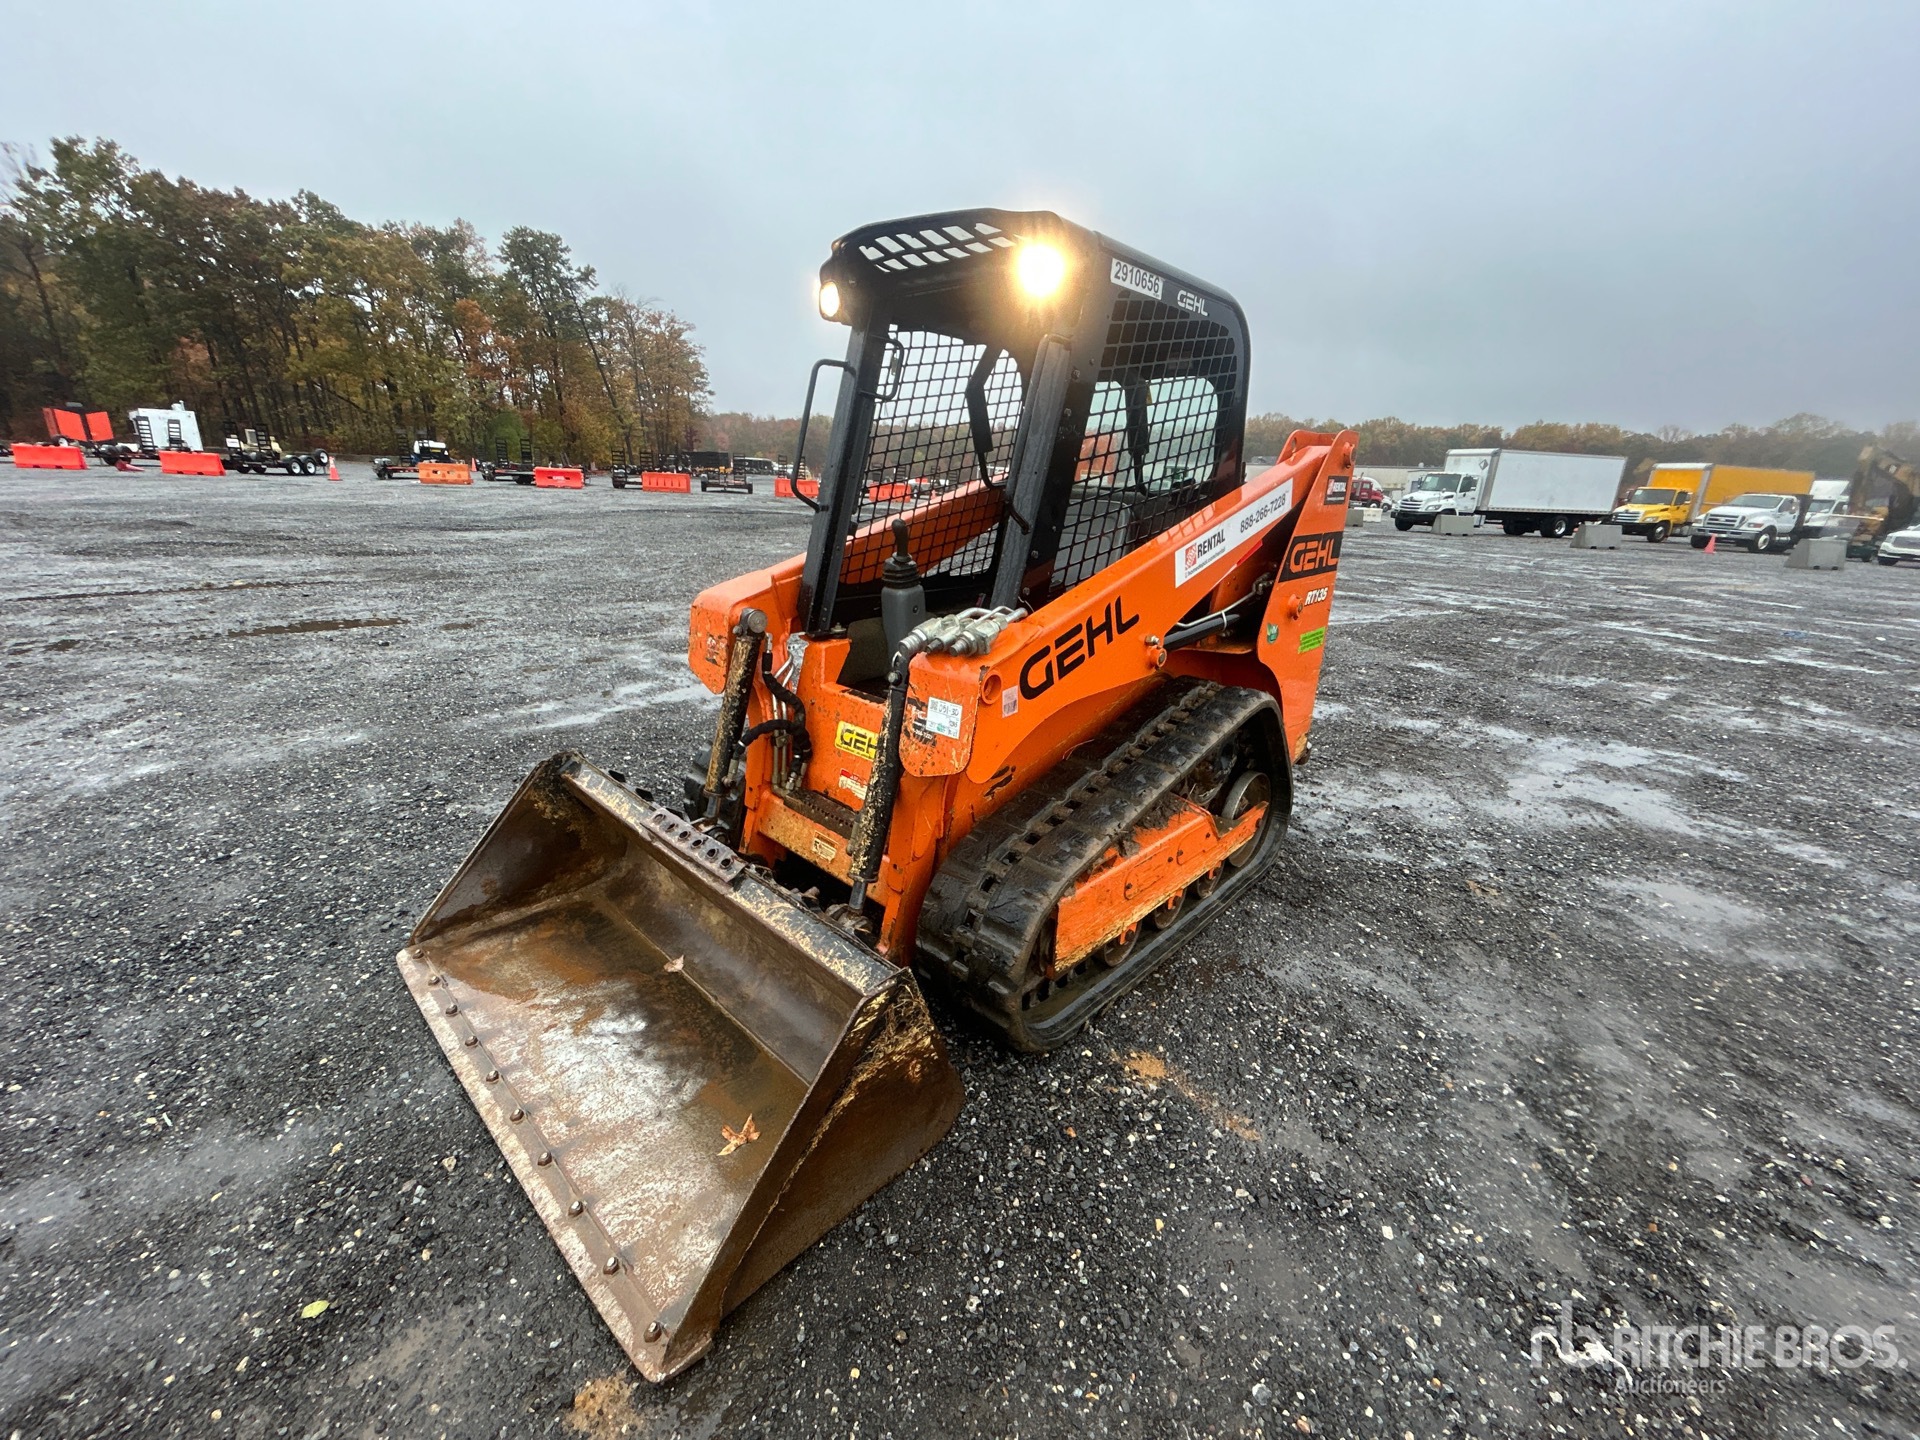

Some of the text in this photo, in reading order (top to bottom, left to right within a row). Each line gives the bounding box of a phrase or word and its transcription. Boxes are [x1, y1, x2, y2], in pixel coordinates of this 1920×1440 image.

[1114, 261, 1160, 294] 2910656
[1177, 289, 1209, 317] GEHL
[1240, 493, 1286, 535] 888-266-7228
[1197, 529, 1226, 559] RENTAL
[1289, 538, 1341, 574] GEHL
[1304, 587, 1329, 606] RT135
[1019, 595, 1140, 700] GEHL
[840, 729, 878, 754] GEH
